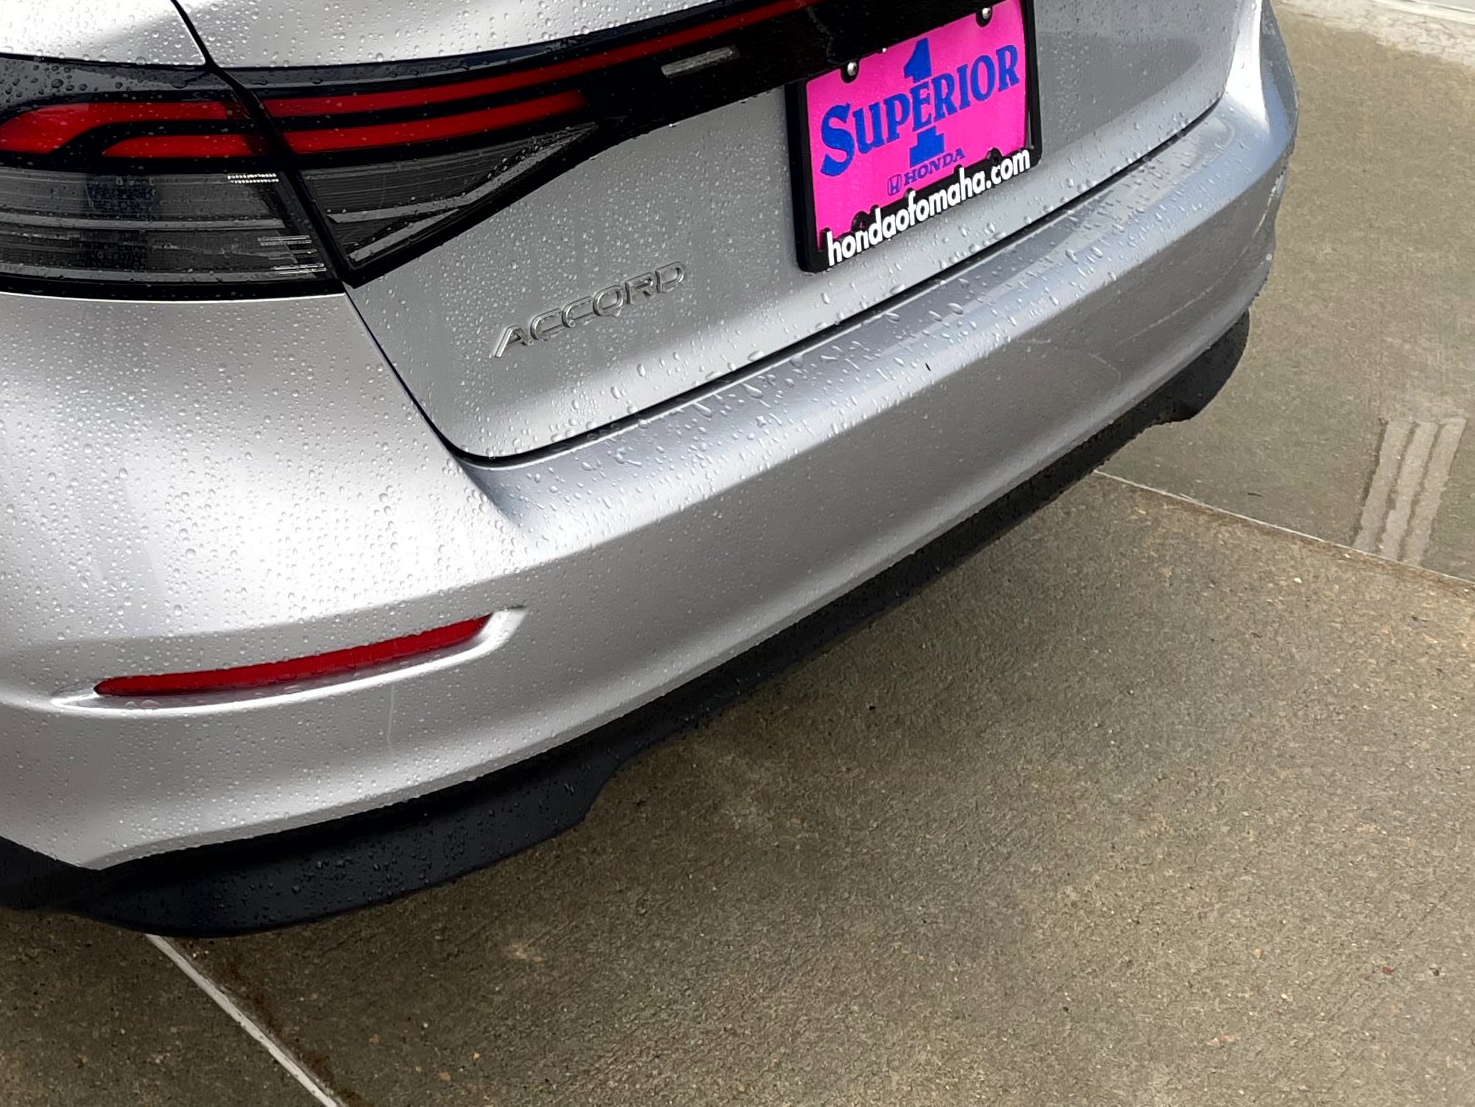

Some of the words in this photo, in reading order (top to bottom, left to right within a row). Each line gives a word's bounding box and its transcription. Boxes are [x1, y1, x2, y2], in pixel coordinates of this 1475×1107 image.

[826, 149, 1031, 267] hondaofomaha.com
[904, 147, 966, 187] HONDA
[492, 261, 686, 358] ACCORD
